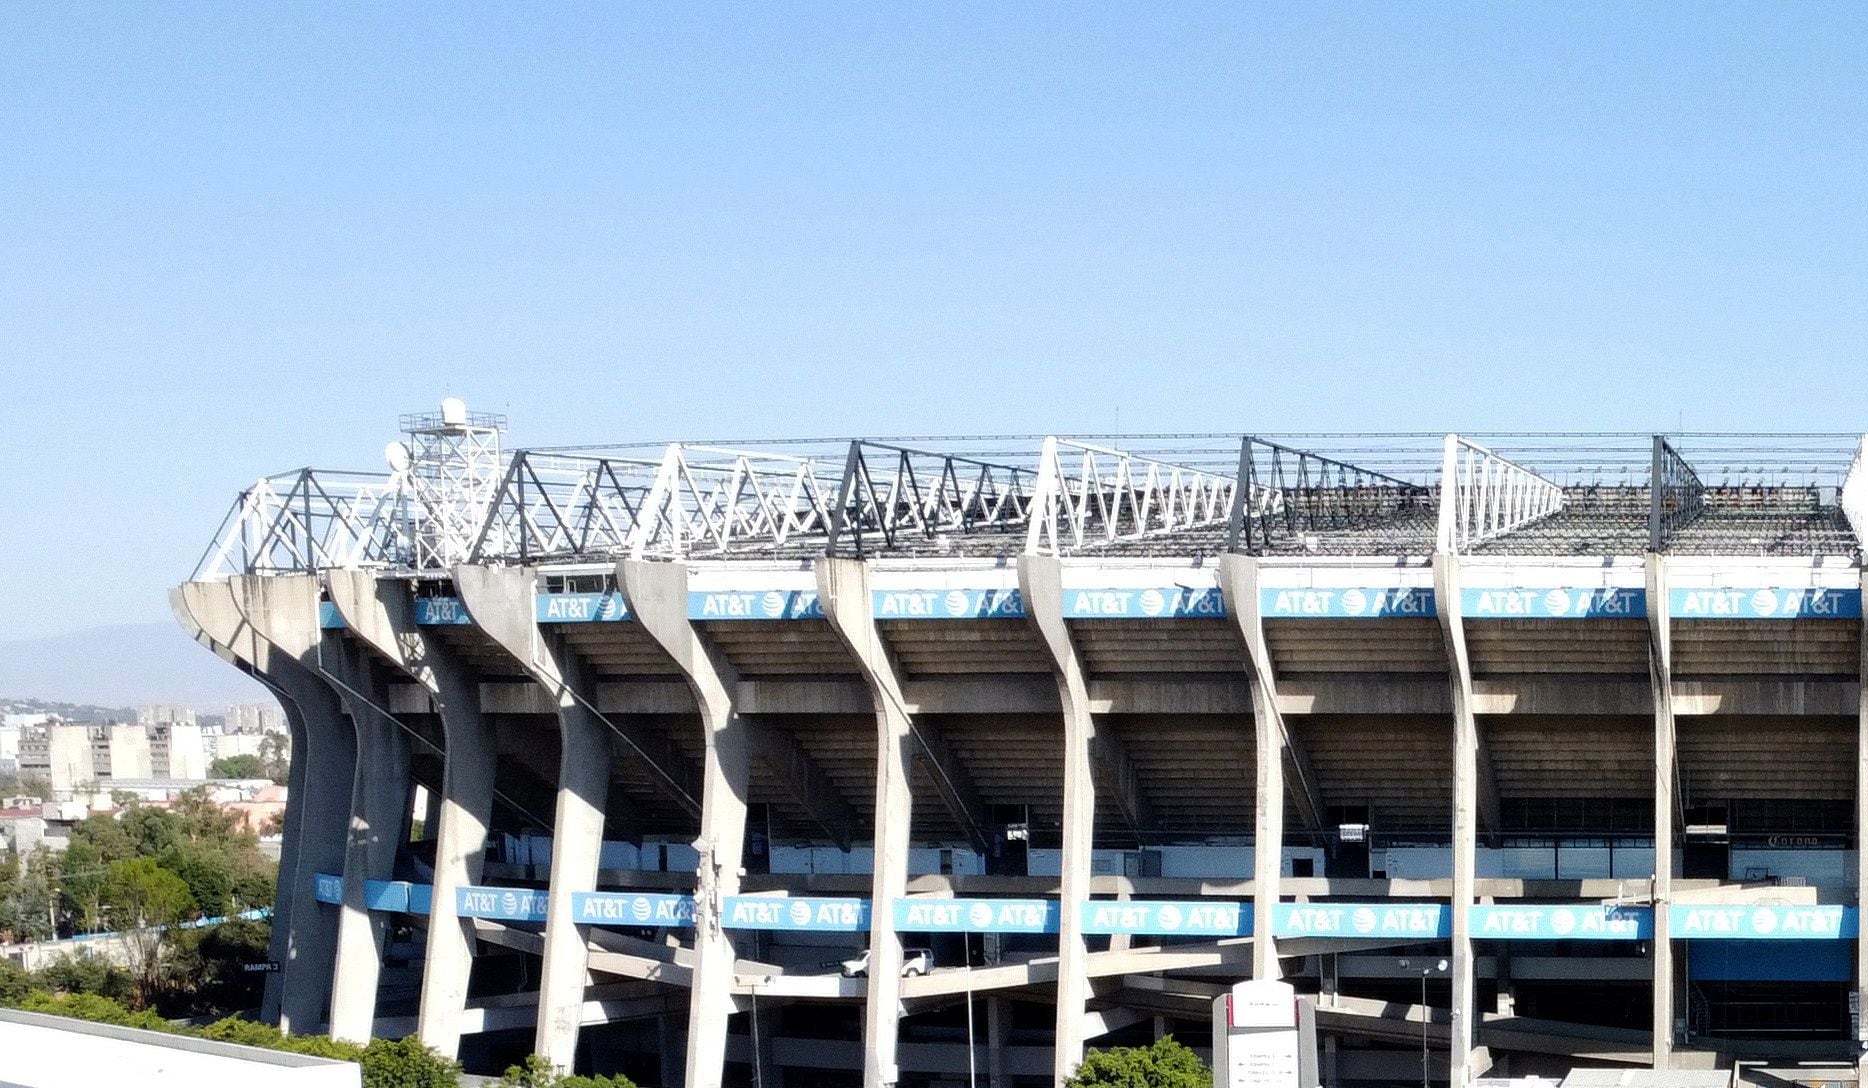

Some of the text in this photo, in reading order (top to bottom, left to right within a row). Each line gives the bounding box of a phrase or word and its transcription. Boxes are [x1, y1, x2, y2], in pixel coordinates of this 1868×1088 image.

[425, 601, 459, 620] AT&T
[547, 597, 591, 618] AT&T
[703, 593, 824, 615] AT&T AT&
[881, 593, 938, 614] AT&T
[1074, 592, 1133, 614] AT&T
[1274, 592, 1433, 614] AT&T AT&T
[1476, 591, 1635, 614] AT&T AT&T
[1683, 592, 1842, 614] AT&T AT&T
[1768, 836, 1818, 846] Corona
[464, 892, 548, 914] AT&T AT&
[583, 898, 627, 918] AT&T
[733, 903, 867, 924] AT&T AT&T
[907, 904, 1052, 927] AT&T AT&T
[1094, 907, 1244, 929] AT&T AT&T
[1287, 910, 1439, 931] AT&T AT&T
[1484, 911, 1638, 932] AT&T AT&T
[1684, 910, 1842, 932] AT&T AT&T
[244, 963, 272, 971] RAMPA
